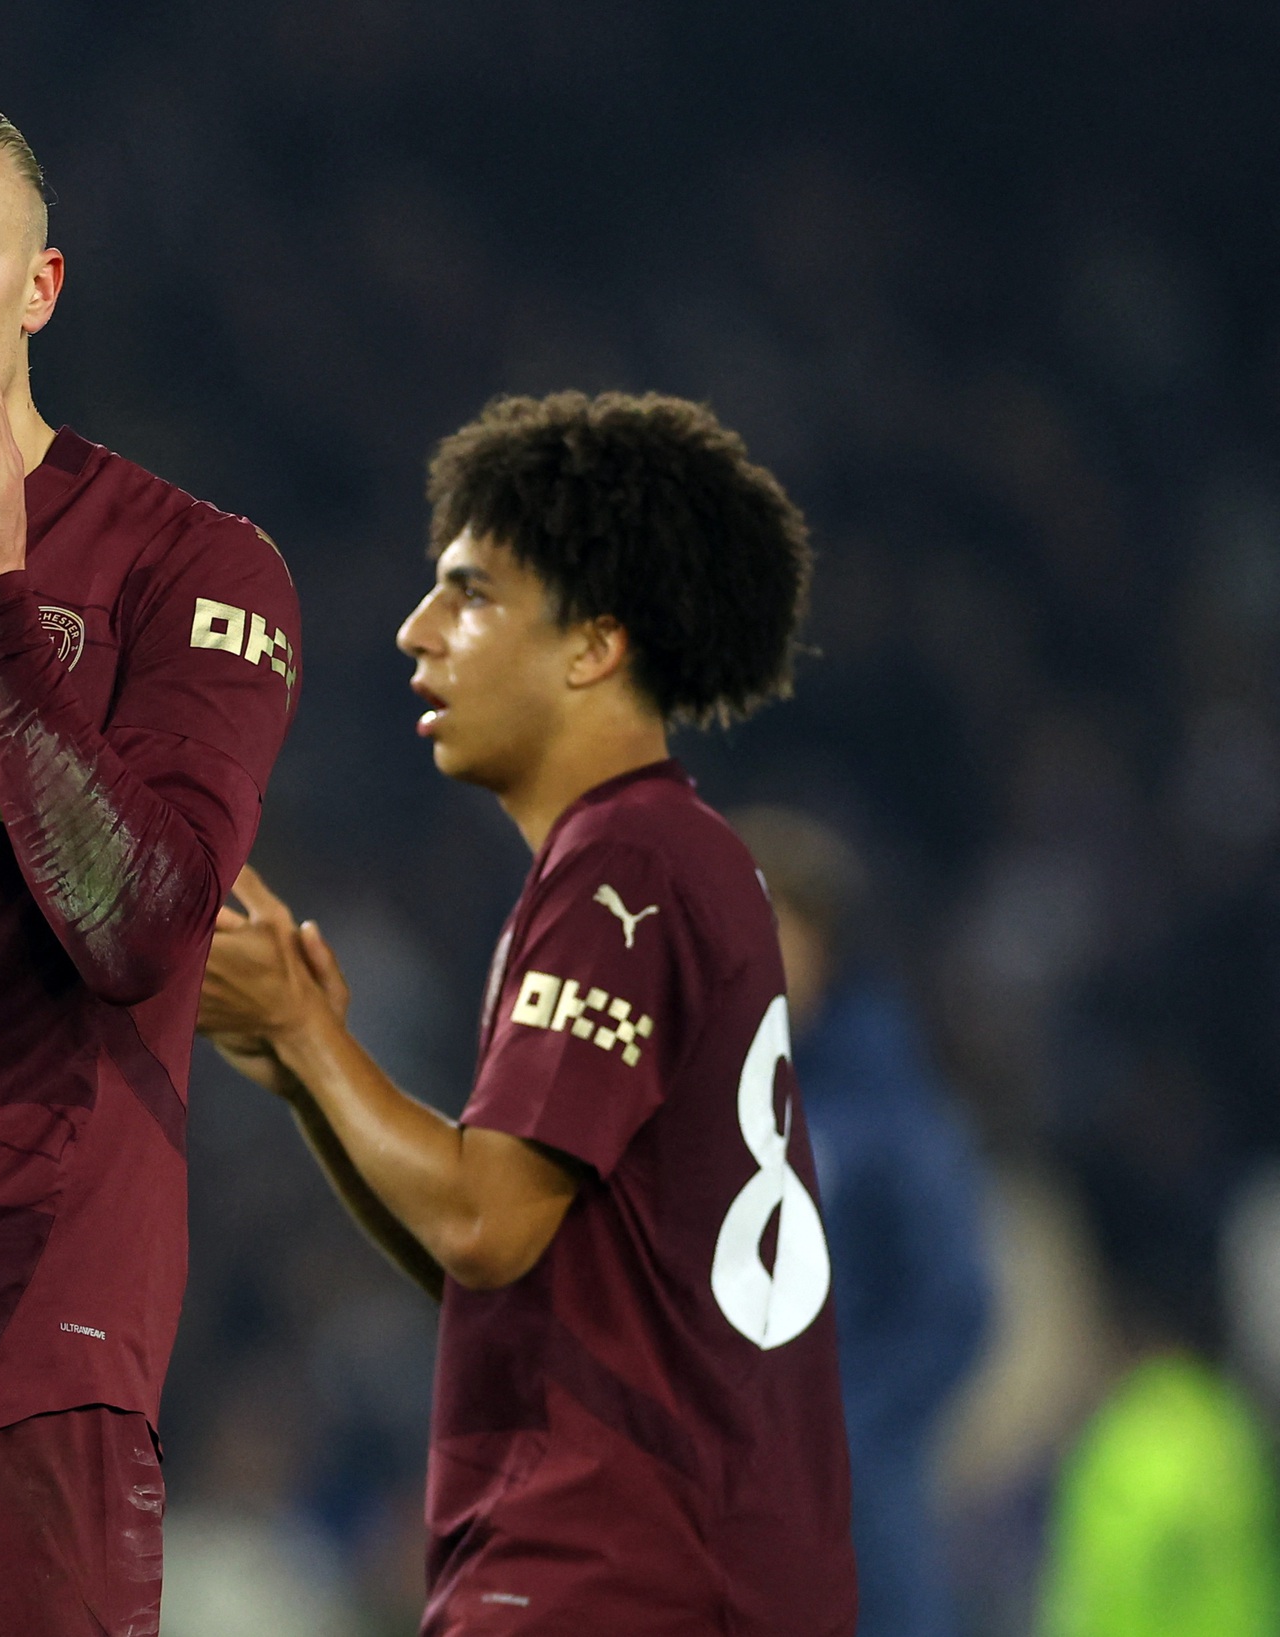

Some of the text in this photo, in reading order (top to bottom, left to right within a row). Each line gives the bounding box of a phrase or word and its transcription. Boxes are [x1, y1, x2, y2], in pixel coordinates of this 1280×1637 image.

[510, 970, 654, 1068] OKX
[711, 994, 831, 1351] 8
[60, 1322, 106, 1341] ULTRAWEAVE
